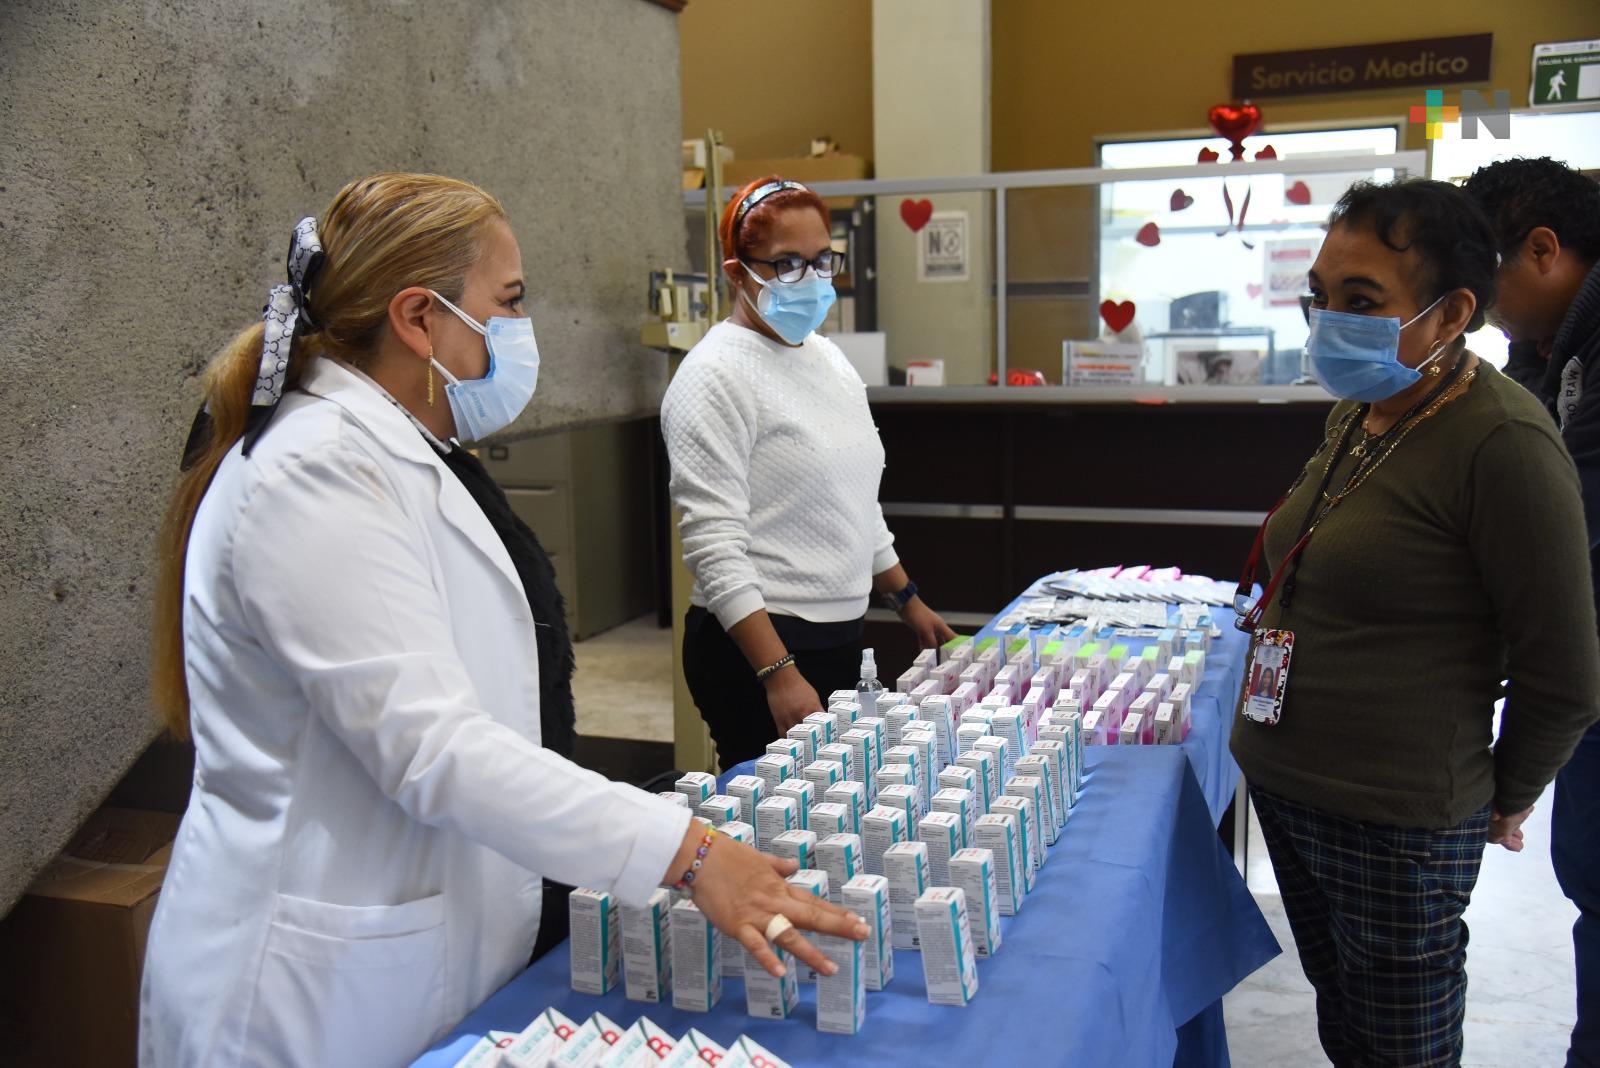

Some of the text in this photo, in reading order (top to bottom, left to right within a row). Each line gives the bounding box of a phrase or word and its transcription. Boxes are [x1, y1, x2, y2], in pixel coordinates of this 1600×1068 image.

[1251, 52, 1469, 90] Servicio Medico
[1565, 369, 1580, 397] RAW
